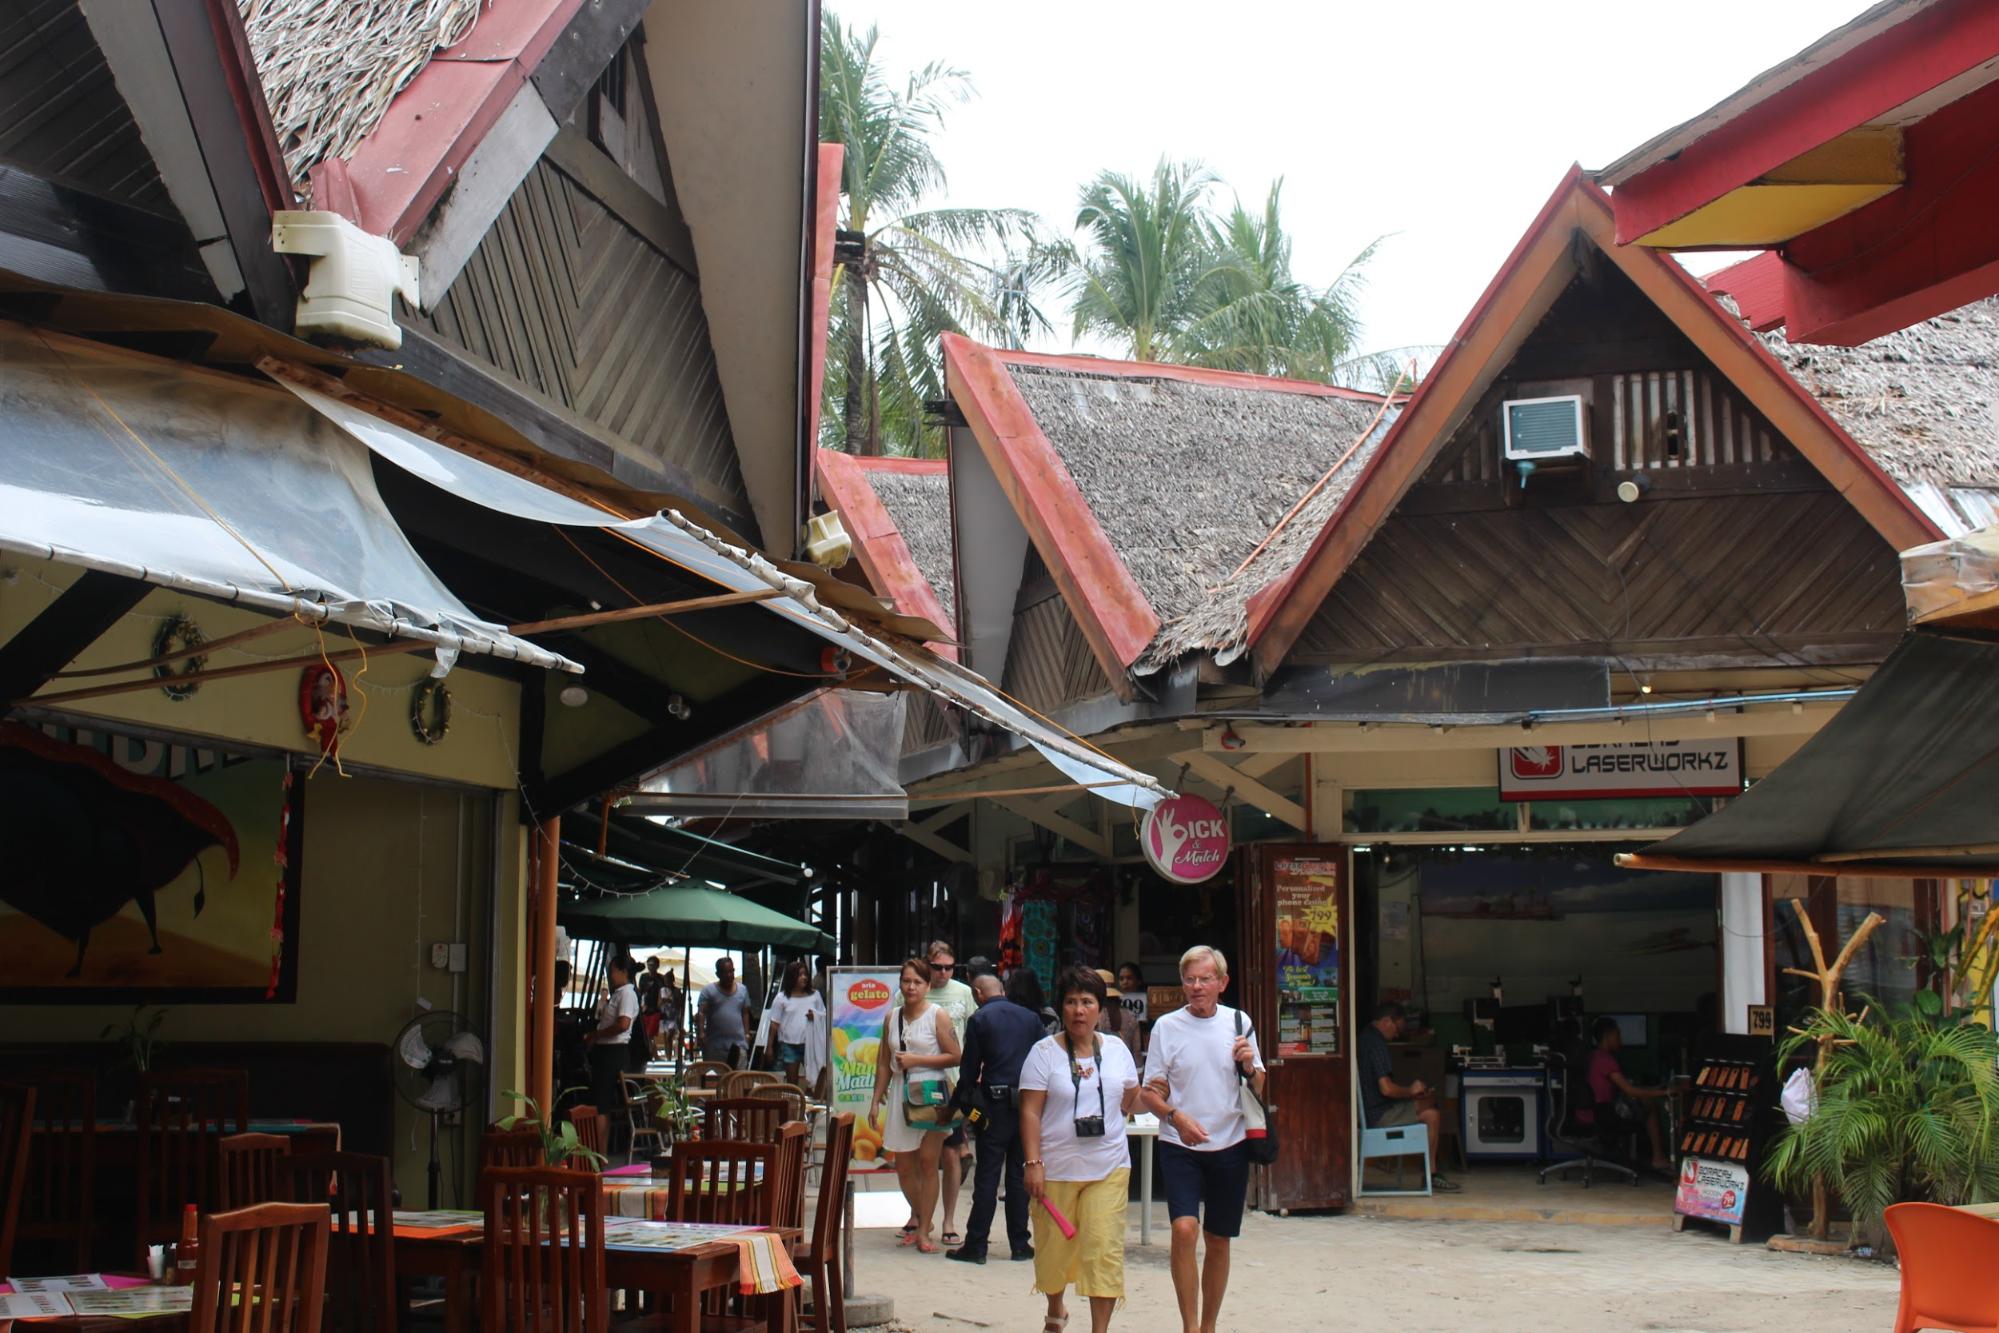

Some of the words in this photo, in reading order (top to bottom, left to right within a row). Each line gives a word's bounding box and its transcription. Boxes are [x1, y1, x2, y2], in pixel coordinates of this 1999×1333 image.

[1571, 751, 1728, 774] LASERWORKZ
[1192, 841, 1201, 849] &
[1174, 849, 1220, 866] Match
[1310, 910, 1332, 920] 799
[850, 989, 889, 1002] gelato
[1752, 1011, 1771, 1029] 799
